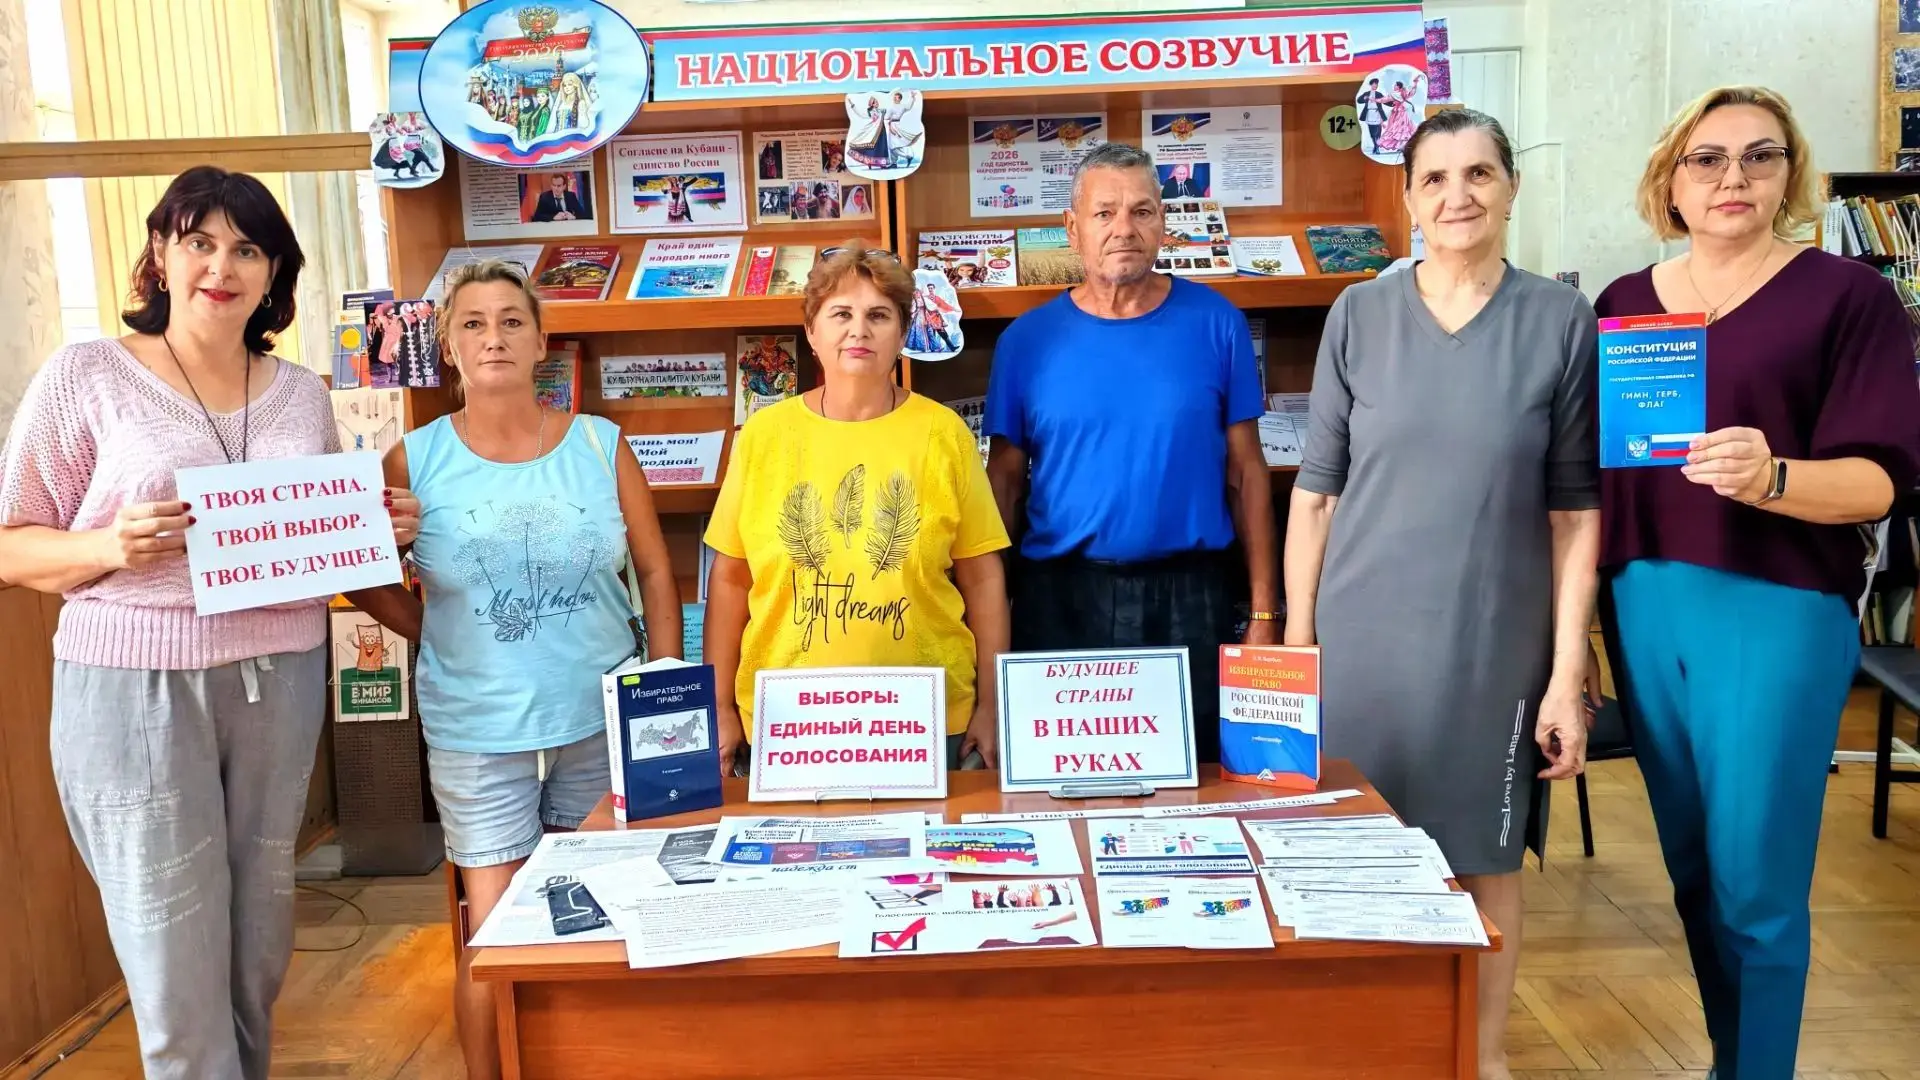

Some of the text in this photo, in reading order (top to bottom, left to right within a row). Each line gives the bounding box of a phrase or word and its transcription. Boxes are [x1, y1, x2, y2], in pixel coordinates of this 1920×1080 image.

[676, 32, 1354, 87] НАЦИОНАЛЬНОЕ СОЗВУЧИЕ
[1327, 115, 1357, 134] 12+
[619, 145, 668, 157] Согласие
[686, 143, 725, 156] Кубани
[990, 151, 1019, 160] 2026
[633, 159, 720, 170] единство России
[657, 243, 685, 251] Край
[688, 242, 715, 250] один
[649, 255, 695, 263] народов
[1606, 341, 1697, 356] КОНСТИТУЦИЯ
[1607, 354, 1697, 365] РОССИЙСКОЙ ФЕДЕРАЦИИ
[606, 373, 722, 385] КУЛЬТУРНАЯ ПАЛИТРА КУБАНИ
[1621, 389, 1681, 400] ГИМН, ГЕРБ,
[1638, 401, 1664, 409] ФЛАГ
[630, 437, 699, 447] бань моя!
[638, 448, 668, 456] Мой
[640, 457, 698, 467] родной!
[200, 478, 367, 510] ТВОЯ СТРАНА.
[212, 513, 367, 548] ТВОЙ ВЫБОР.
[201, 546, 390, 588] ТВОЕ БУДУЩЕЕ.
[792, 569, 832, 652] Light
[835, 572, 911, 641] dreams
[1046, 661, 1140, 680] БУДУЩЕЕ
[1229, 666, 1306, 681] ИЗБИРАТЕЛЬНОЕ
[631, 683, 703, 700] ИЗБИРАТЕЛЬНОЕ
[1252, 679, 1282, 689] ПРАВО
[362, 686, 392, 698] МИР
[798, 690, 899, 706] ВЫБОРЫ:
[1055, 687, 1134, 704] СТРАНЫ
[656, 695, 684, 705] ПРАВО
[1231, 692, 1304, 709] РОССИЙСКОЙ
[1232, 707, 1303, 723] ФЕДЕРАЦИИ
[769, 718, 927, 739] ЕДИНЫЙ ДЕНЬ
[1033, 715, 1161, 738] В НАШИХ
[767, 748, 928, 766] ГОЛОСОВАНИЯ
[1054, 752, 1144, 773] РУКАХ
[1501, 733, 1520, 813] Love by Lana
[771, 863, 834, 873] надежда
[875, 907, 1049, 919] Голосование, выборы, референдум
